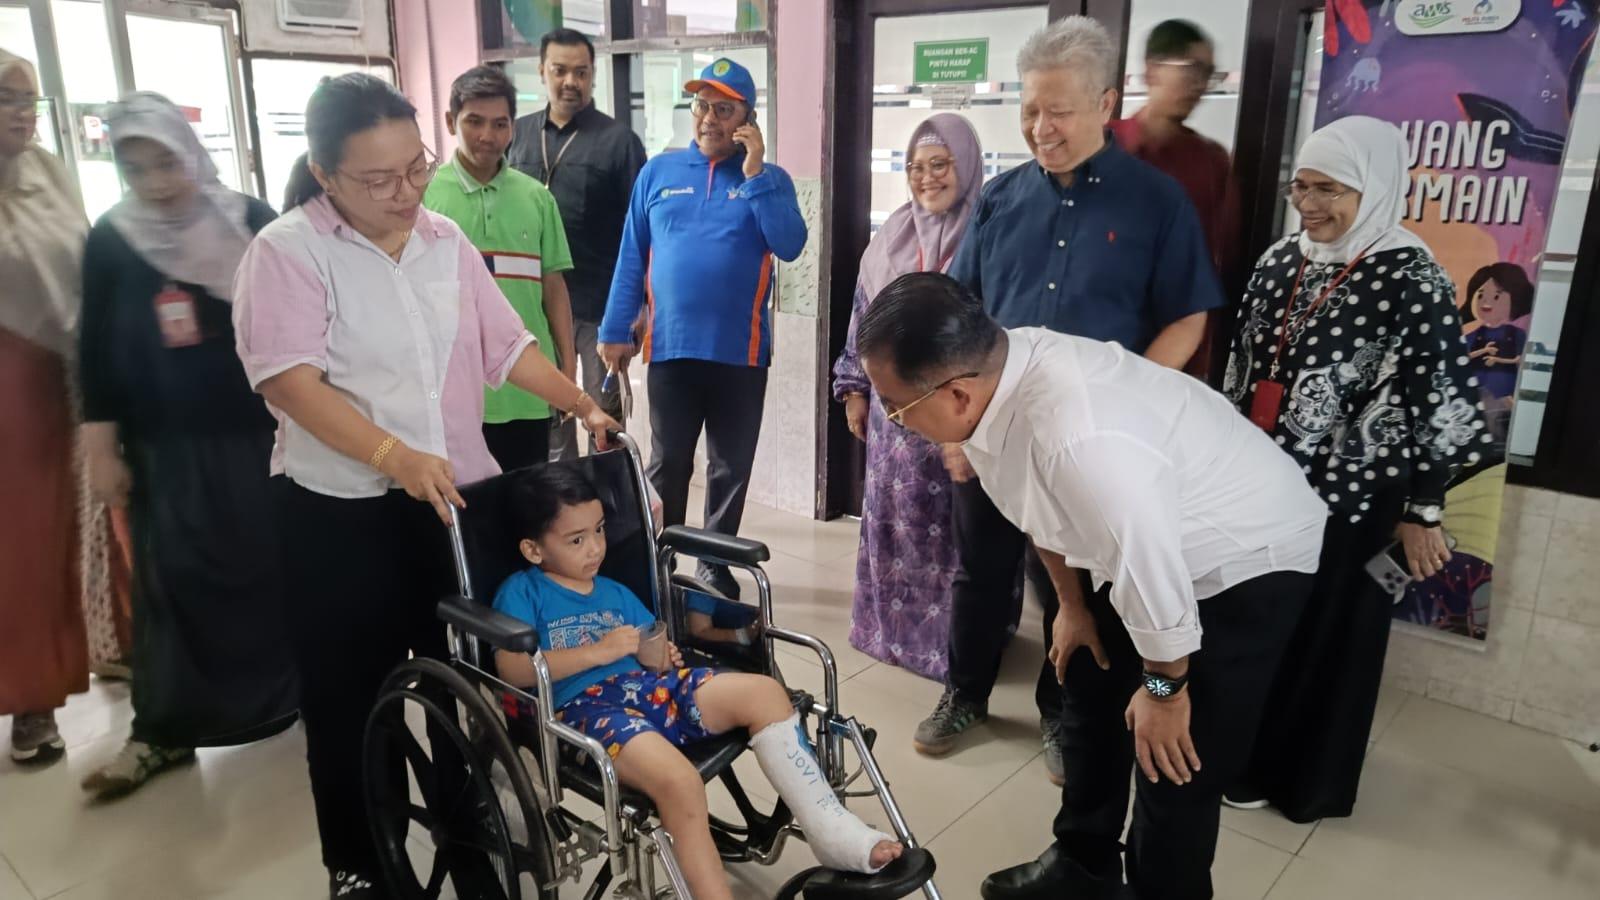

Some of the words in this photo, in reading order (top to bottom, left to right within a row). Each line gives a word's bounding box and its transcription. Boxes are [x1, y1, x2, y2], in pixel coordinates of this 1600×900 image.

[923, 48, 953, 57] RUANGAN
[928, 60, 948, 68] PINTU
[949, 58, 972, 67] HARAP
[932, 71, 939, 79] DI
[787, 751, 818, 786] JOVI
